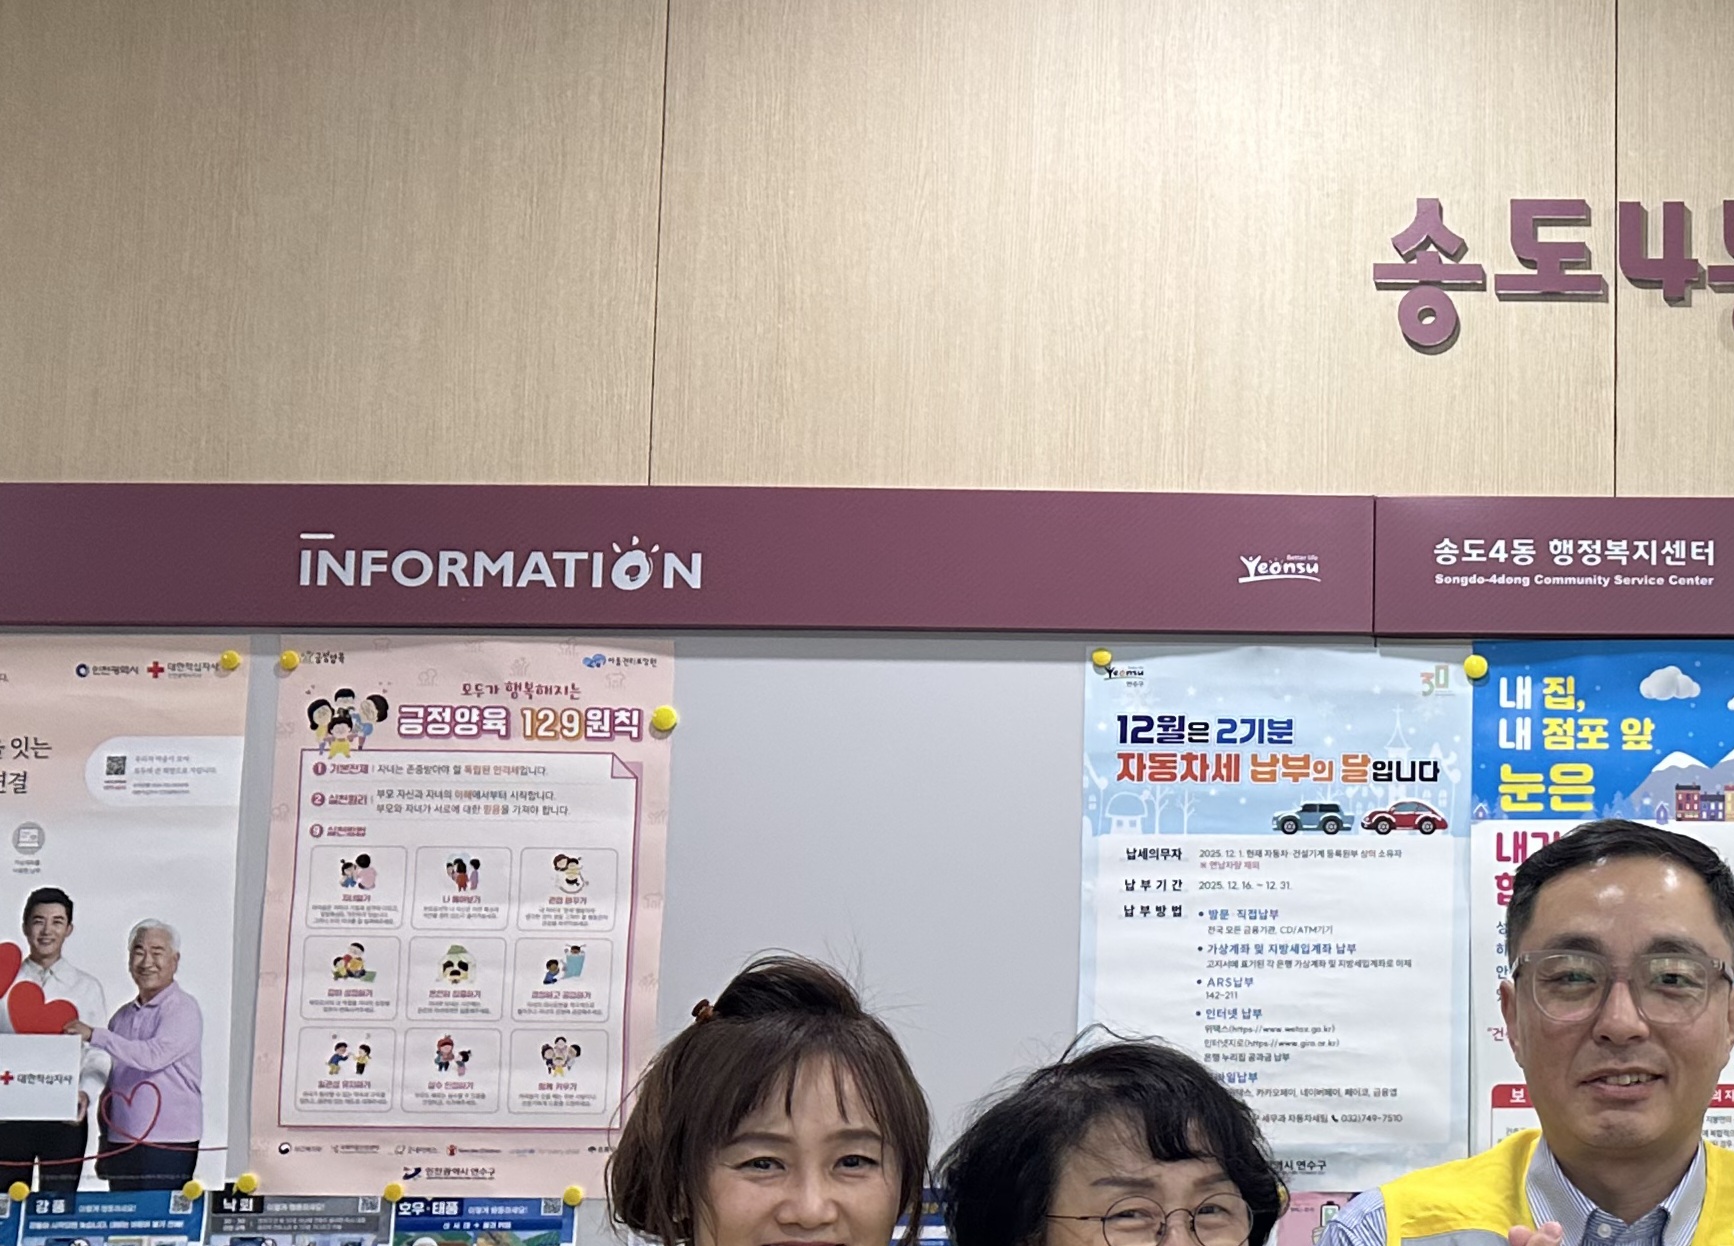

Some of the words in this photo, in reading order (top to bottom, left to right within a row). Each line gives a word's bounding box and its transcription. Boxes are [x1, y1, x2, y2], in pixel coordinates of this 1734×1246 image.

[300, 533, 704, 590] INFORMATION
[1433, 537, 1536, 566] 송도4동
[1549, 537, 1716, 566] 행정복지센터
[1240, 555, 1318, 577] Yeonsu
[1434, 574, 1530, 587] Songdo-4dong
[1534, 574, 1609, 587] Community
[1614, 574, 1664, 585] Service
[1668, 574, 1714, 585] Center
[461, 683, 498, 697] 모두가
[505, 682, 581, 700] 행복해지는
[1499, 676, 1531, 710] 내
[1542, 676, 1586, 713] 집,
[398, 706, 508, 737] 긍정양육
[1117, 715, 1210, 744] 12월은
[1216, 718, 1294, 744] 2기분
[1499, 717, 1531, 751] 내
[1542, 717, 1610, 750] 점포
[1620, 717, 1655, 750] 앞
[11, 736, 52, 759] 잇는
[1116, 752, 1241, 783] 자동차세
[1250, 752, 1333, 783] 납부의
[1341, 752, 1440, 783] 달입니다
[1498, 763, 1595, 812] 눈은
[1126, 848, 1182, 860] 납세의무자
[1199, 881, 1224, 890] 2025.
[1336, 943, 1357, 954] 납부
[1207, 977, 1253, 987] ARS납부
[1206, 1009, 1238, 1019] 인터넷
[1242, 1008, 1262, 1019] 납부
[1297, 1160, 1326, 1170] 연수구
